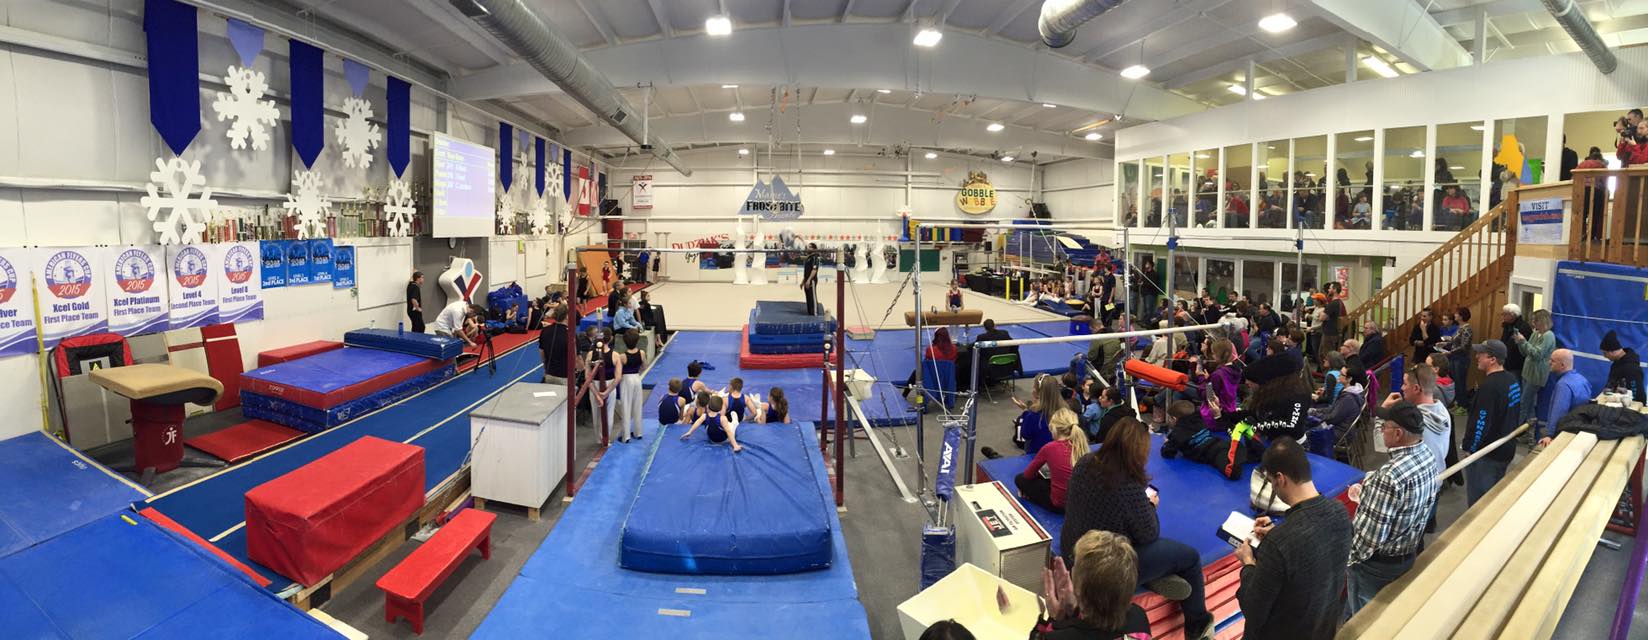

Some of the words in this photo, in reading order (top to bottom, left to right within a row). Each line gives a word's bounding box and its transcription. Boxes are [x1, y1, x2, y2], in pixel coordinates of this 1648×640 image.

[961, 188, 994, 198] GOBBLE
[960, 197, 995, 206] WBBE
[1531, 201, 1550, 210] VISIT
[183, 275, 202, 286] 2015
[231, 272, 247, 282] 2015
[57, 284, 82, 296] 2015
[125, 280, 147, 291] 2015
[231, 286, 244, 294] Level
[183, 291, 197, 300] Level
[114, 298, 128, 306] Xcel
[129, 296, 160, 305] Platinum
[53, 304, 70, 312] Xcel
[72, 302, 89, 311] Gold
[114, 308, 127, 316] First
[128, 306, 144, 315] Place
[145, 305, 161, 313] Team
[0, 308, 17, 318] lver
[44, 315, 60, 324] First
[61, 314, 80, 322] Place
[81, 312, 99, 320] Team
[11, 320, 32, 328] Team
